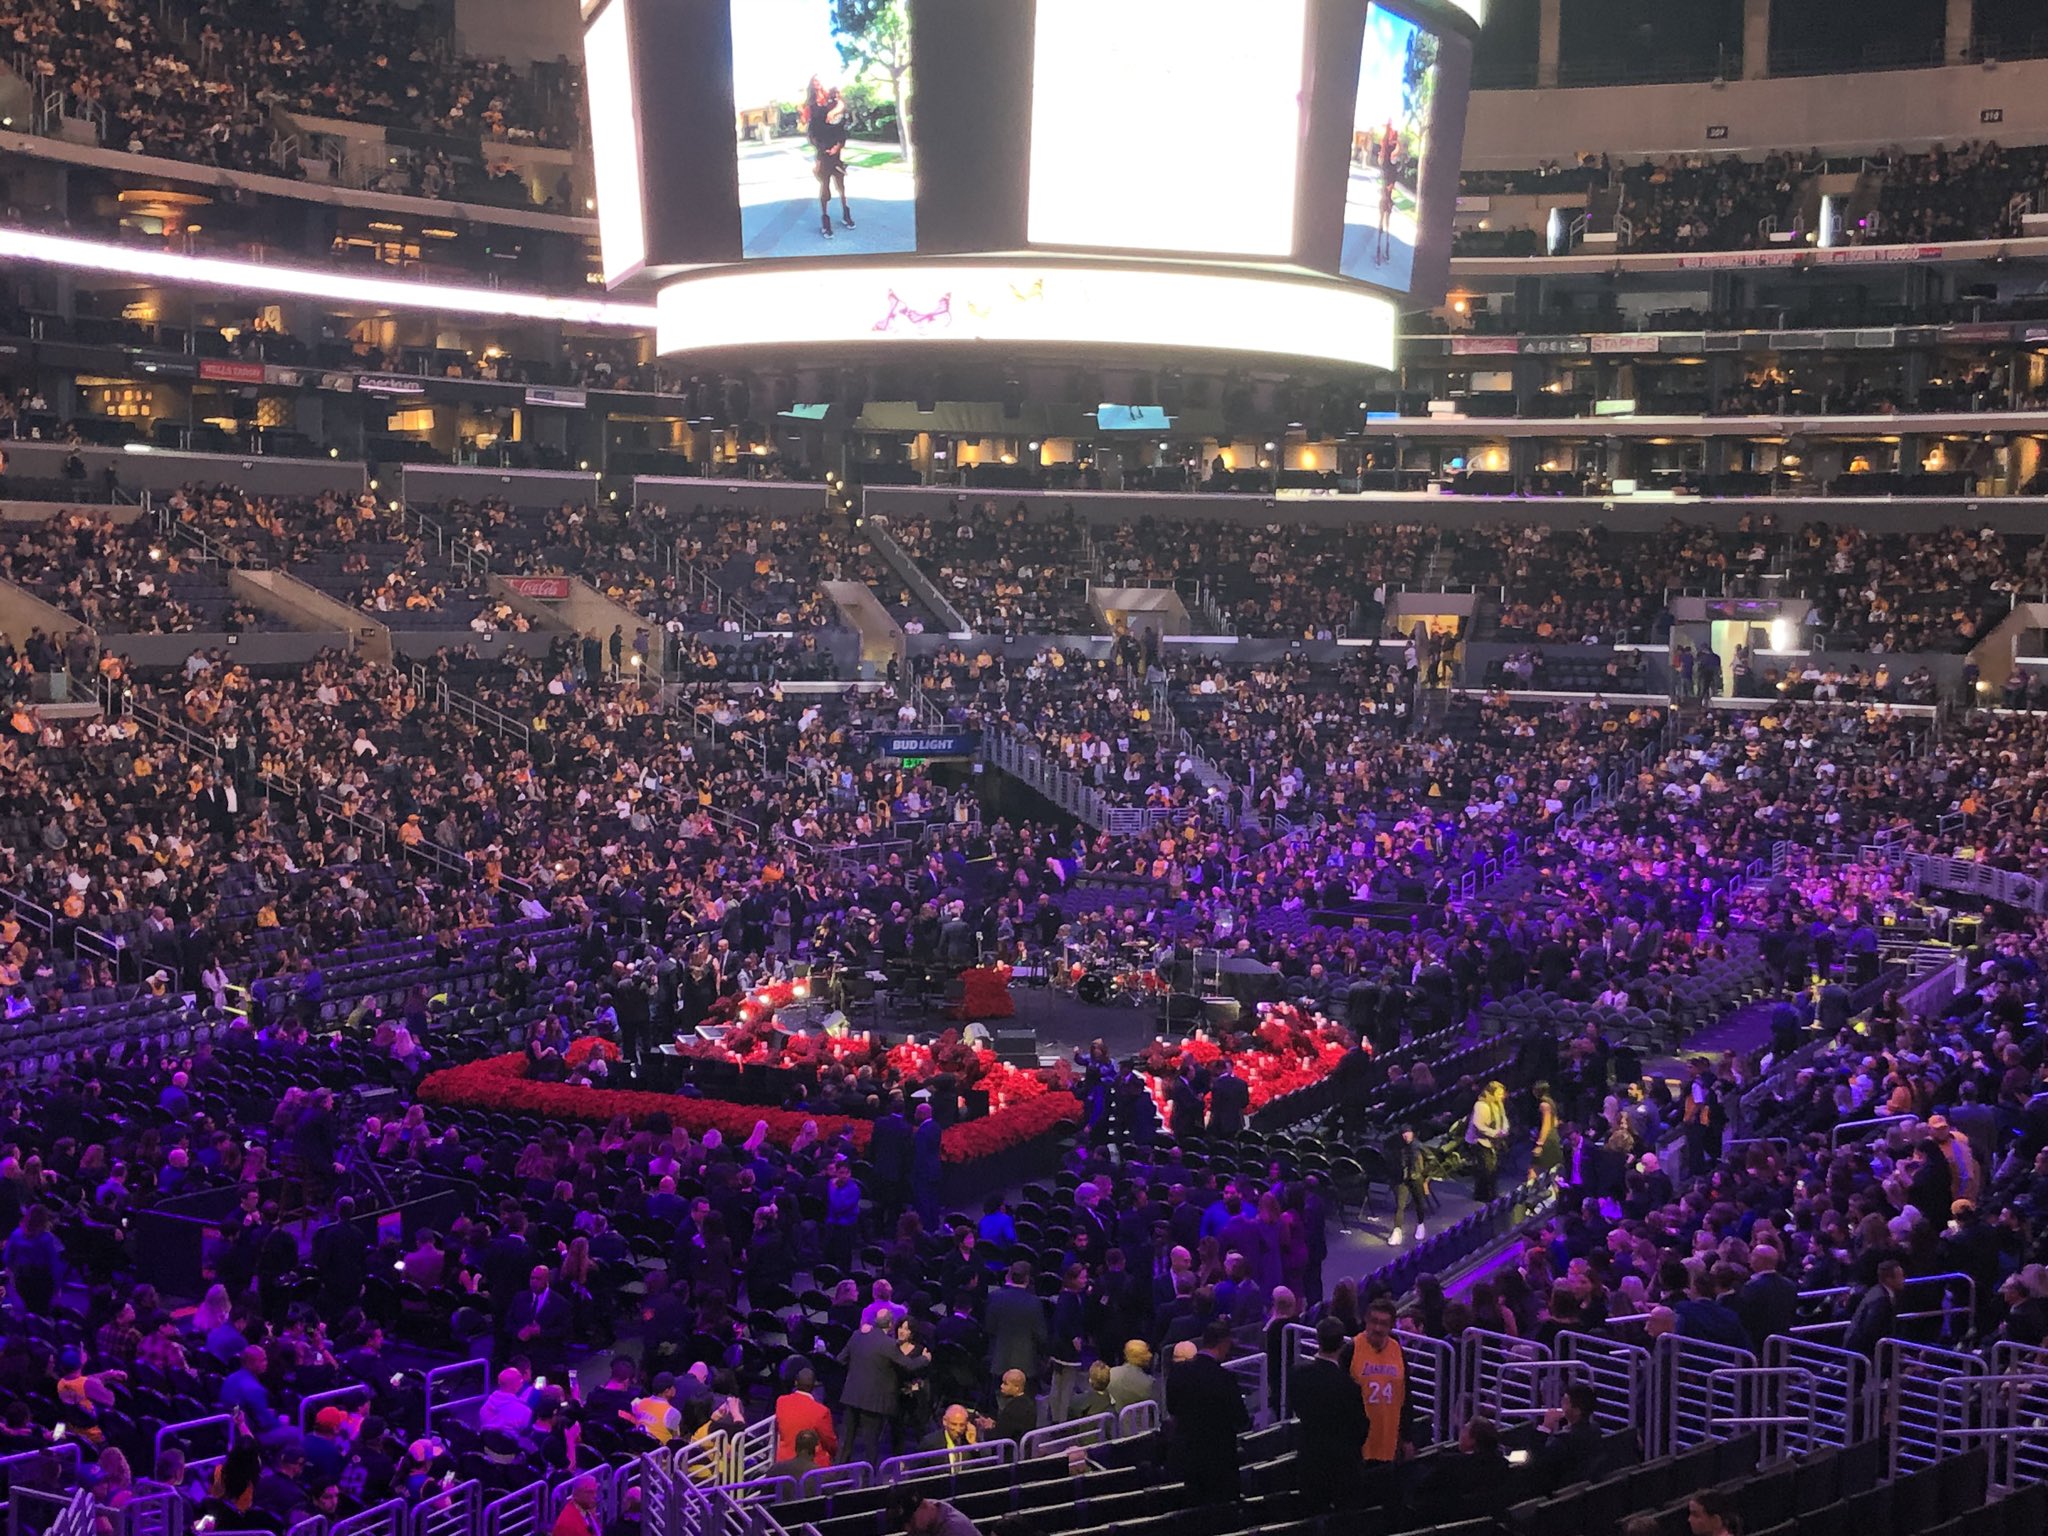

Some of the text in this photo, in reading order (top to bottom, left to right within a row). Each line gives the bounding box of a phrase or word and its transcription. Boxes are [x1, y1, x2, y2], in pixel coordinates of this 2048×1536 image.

[893, 739, 954, 750] BUD LIGHT
[1368, 1381, 1393, 1404] 24
